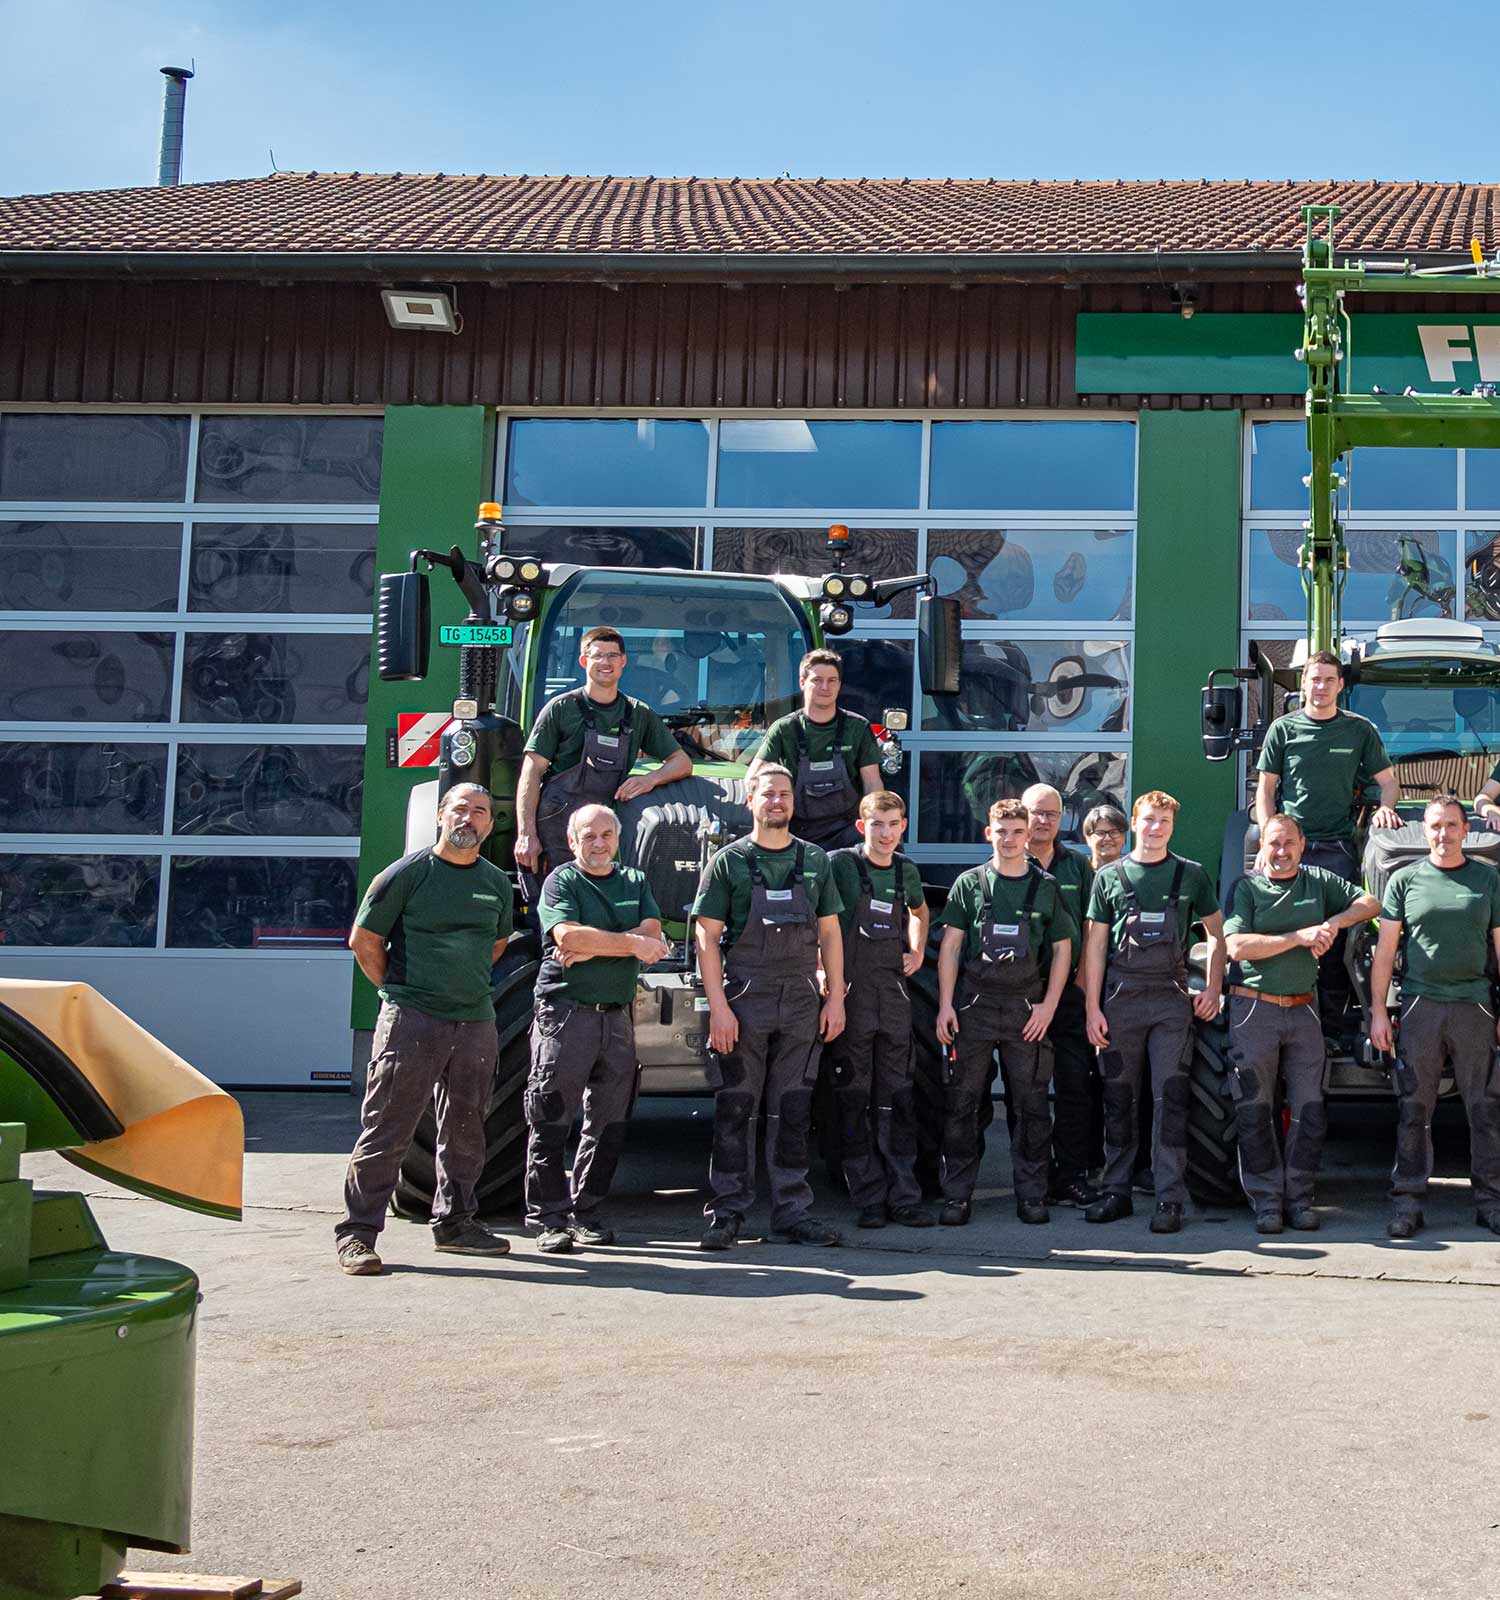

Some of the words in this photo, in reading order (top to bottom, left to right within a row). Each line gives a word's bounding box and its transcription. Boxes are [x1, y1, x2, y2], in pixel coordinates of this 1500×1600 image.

[445, 628, 460, 641] TG
[469, 628, 507, 642] 15458
[674, 860, 703, 871] FE
